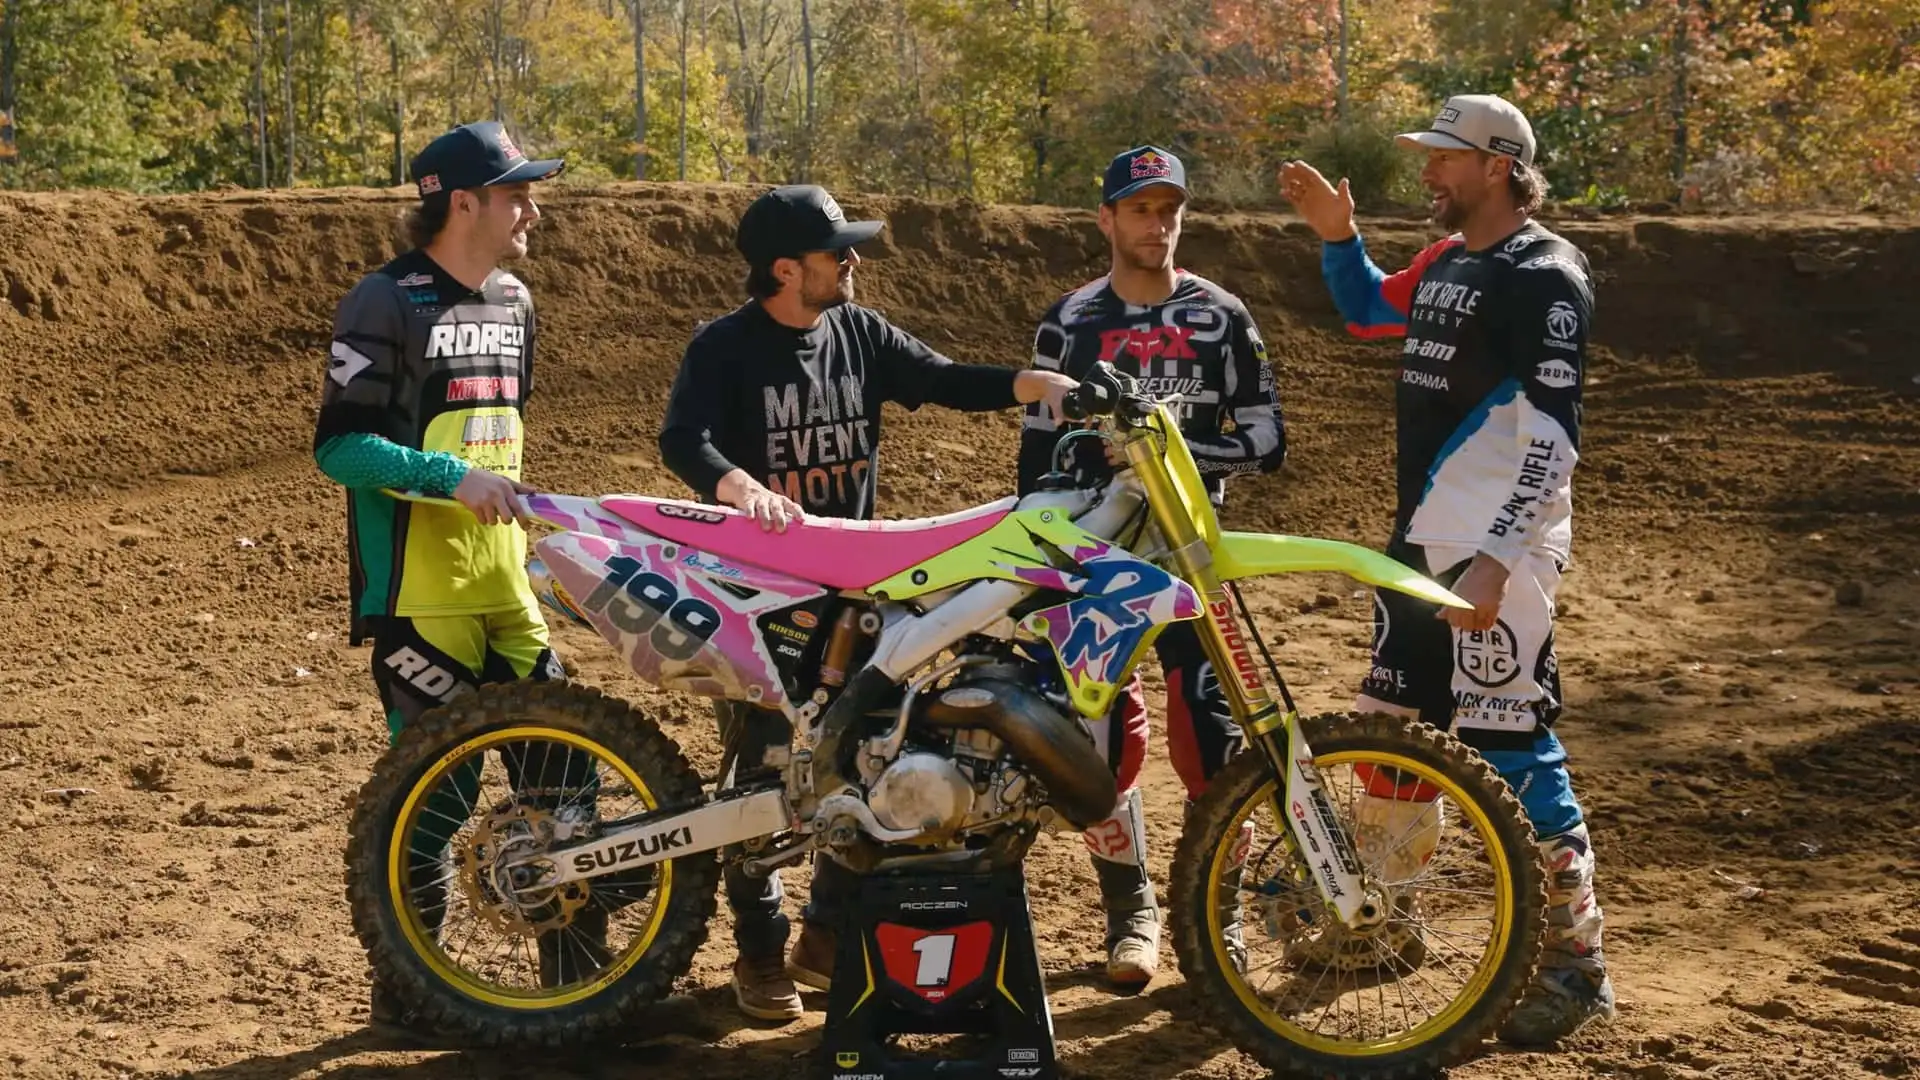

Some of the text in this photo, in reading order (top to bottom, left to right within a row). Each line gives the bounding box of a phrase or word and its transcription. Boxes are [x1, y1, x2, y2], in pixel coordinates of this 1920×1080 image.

[1413, 309, 1463, 328] ERGY
[1434, 282, 1482, 315] RIFLE
[1404, 338, 1457, 361] an-am
[764, 375, 864, 428] MAIN
[1137, 378, 1205, 395] RESSIVE
[767, 419, 870, 469] EVENT
[1518, 438, 1555, 489] RIFLE
[768, 460, 873, 508] MOTO
[581, 555, 722, 661] 199
[1209, 601, 1263, 690] SHOWA
[573, 826, 694, 873] SUZUKI
[900, 901, 968, 910] ROCZEN
[912, 933, 957, 988] 1
